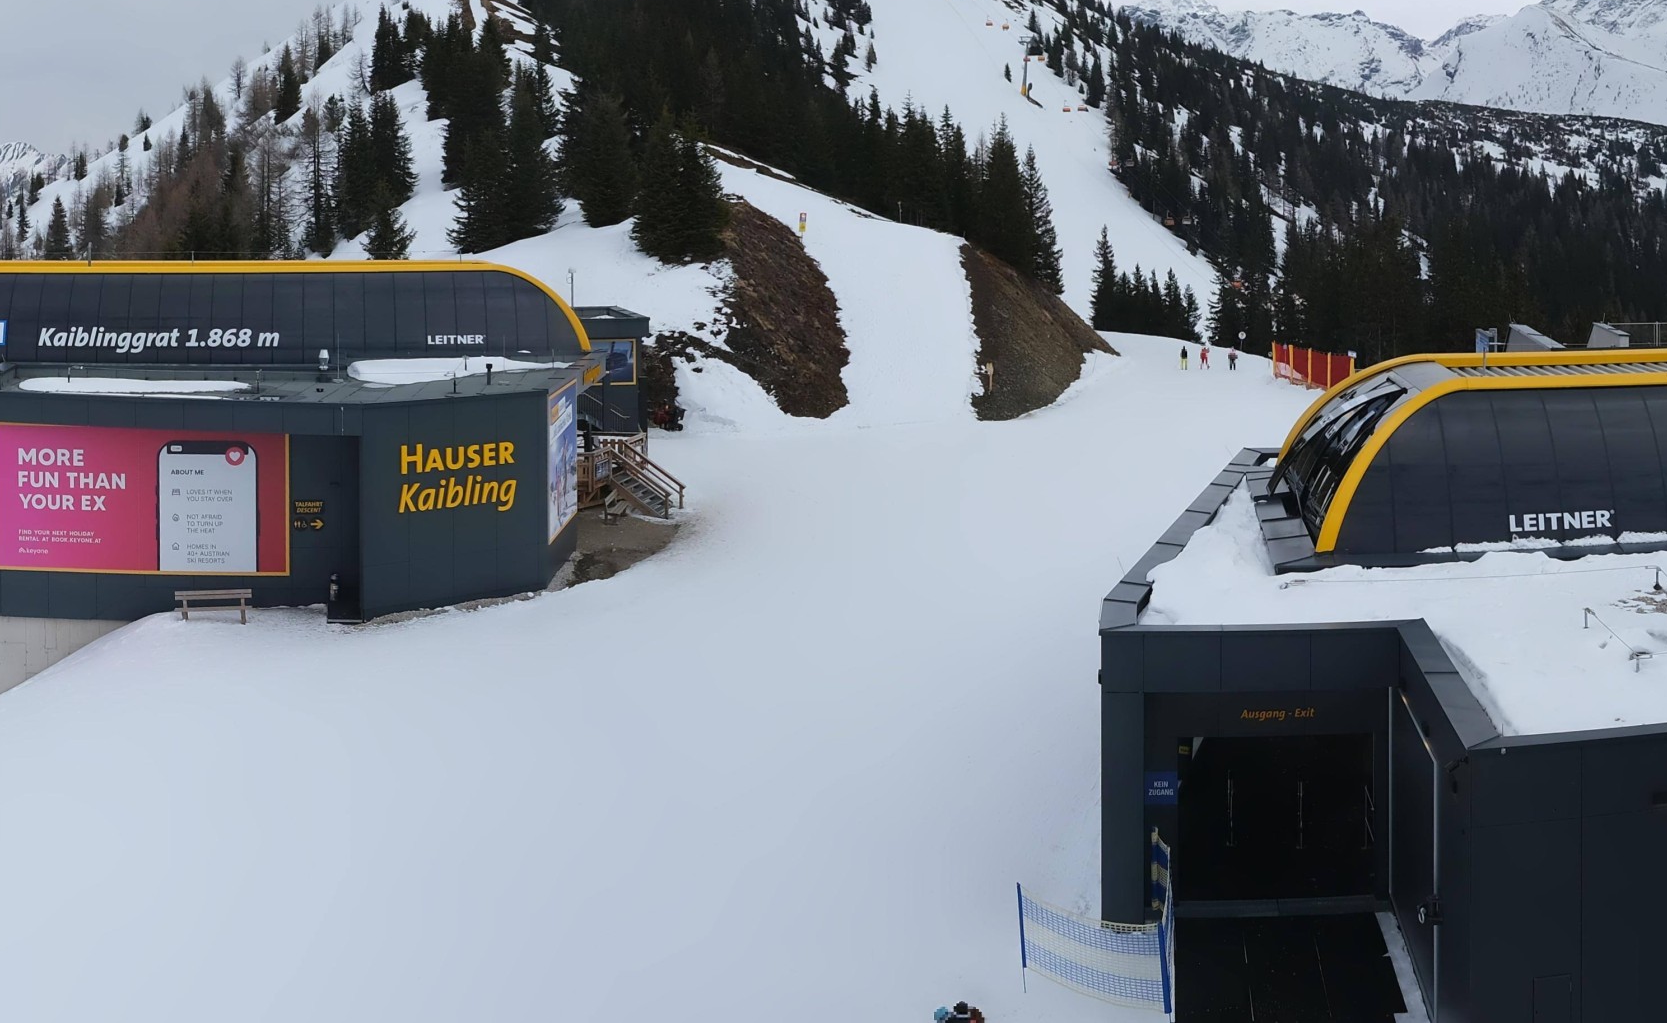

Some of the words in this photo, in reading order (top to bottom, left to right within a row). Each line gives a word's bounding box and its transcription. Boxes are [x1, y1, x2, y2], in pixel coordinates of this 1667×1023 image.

[37, 326, 180, 354] Kaiblinggrat
[184, 328, 252, 348] 1.868
[257, 331, 280, 347] m
[427, 334, 485, 345] LEITNER
[18, 448, 84, 466] MORE
[400, 441, 515, 475] HAUSER
[18, 471, 59, 488] FUN
[66, 472, 126, 489] THAN
[19, 494, 75, 511] YOUR
[81, 495, 107, 511] EX
[398, 475, 517, 514] Kaibling
[1509, 510, 1612, 533] LEITNER
[1240, 709, 1286, 721] Ausgang
[1294, 708, 1315, 718] Exit
[1148, 788, 1174, 796] ZUGANG
[1153, 780, 1169, 788] KEIN
